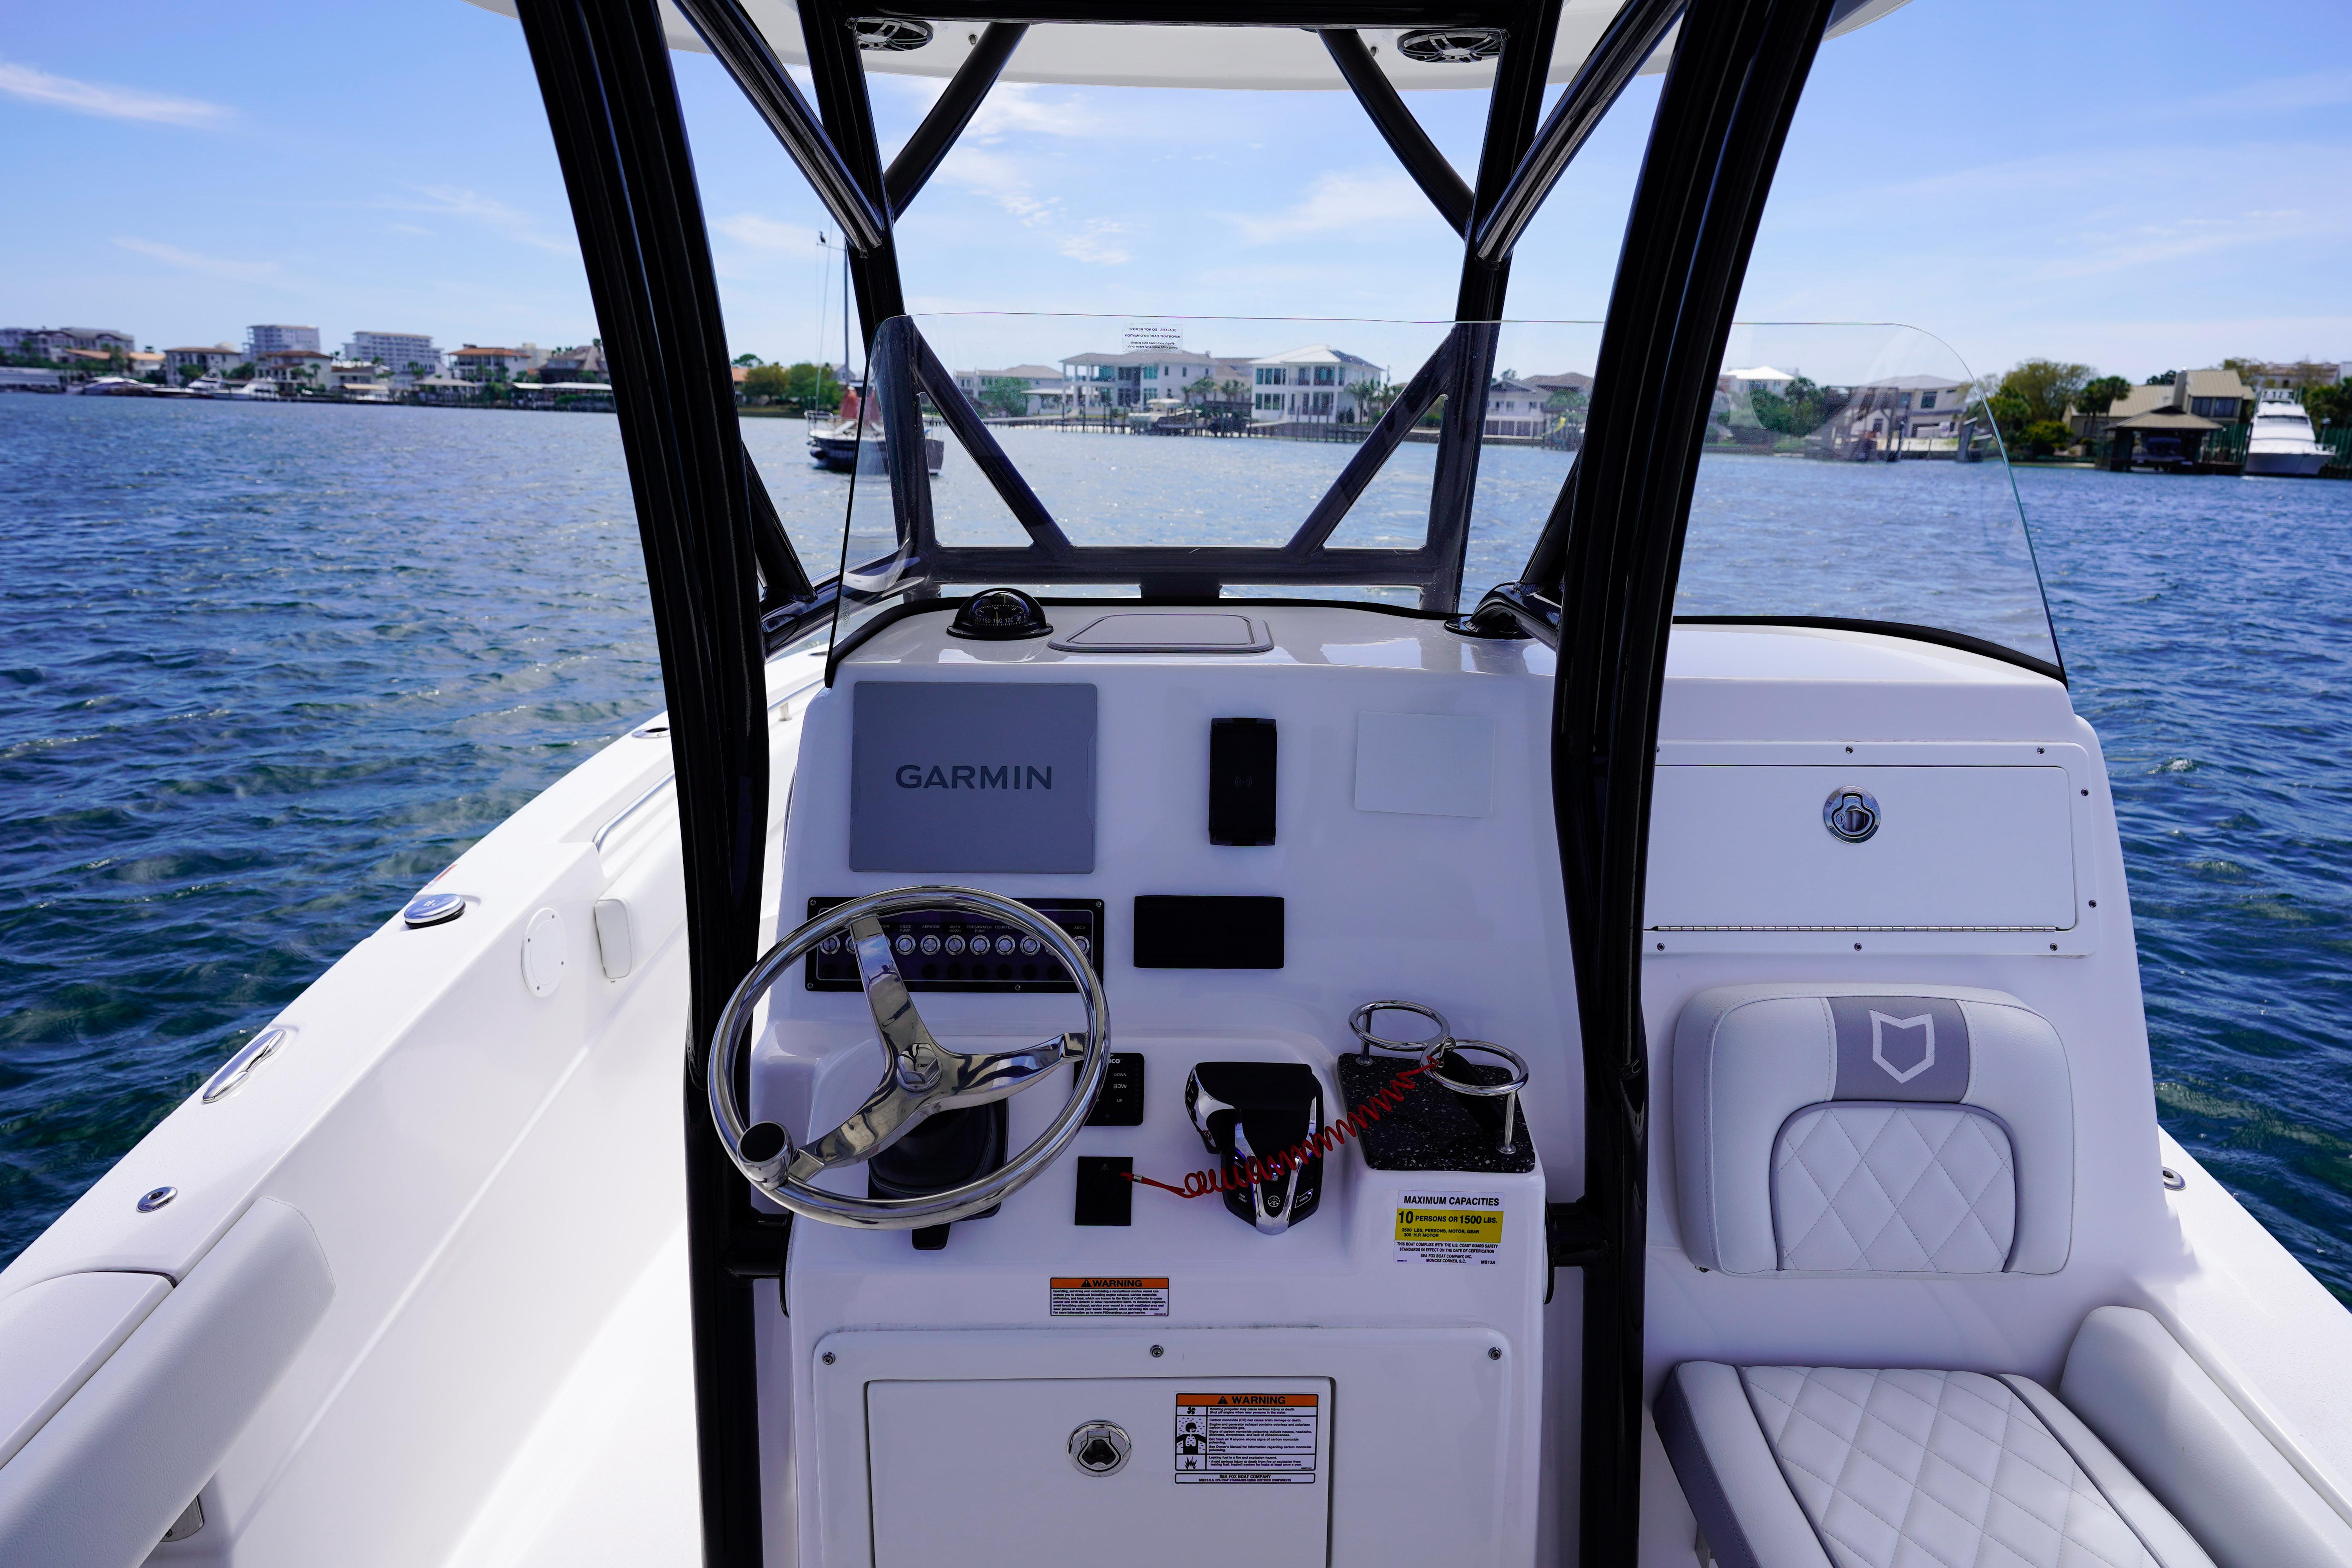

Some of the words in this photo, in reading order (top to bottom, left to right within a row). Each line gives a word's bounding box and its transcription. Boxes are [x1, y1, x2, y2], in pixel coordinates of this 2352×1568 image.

[895, 764, 1052, 789] GARMIN
[1403, 1195, 1446, 1205] MAXIMUM
[1448, 1196, 1499, 1206] CAPACITIES
[1399, 1210, 1414, 1223] 10
[1459, 1215, 1482, 1224] 1500
[1231, 1396, 1285, 1404] WARNING
